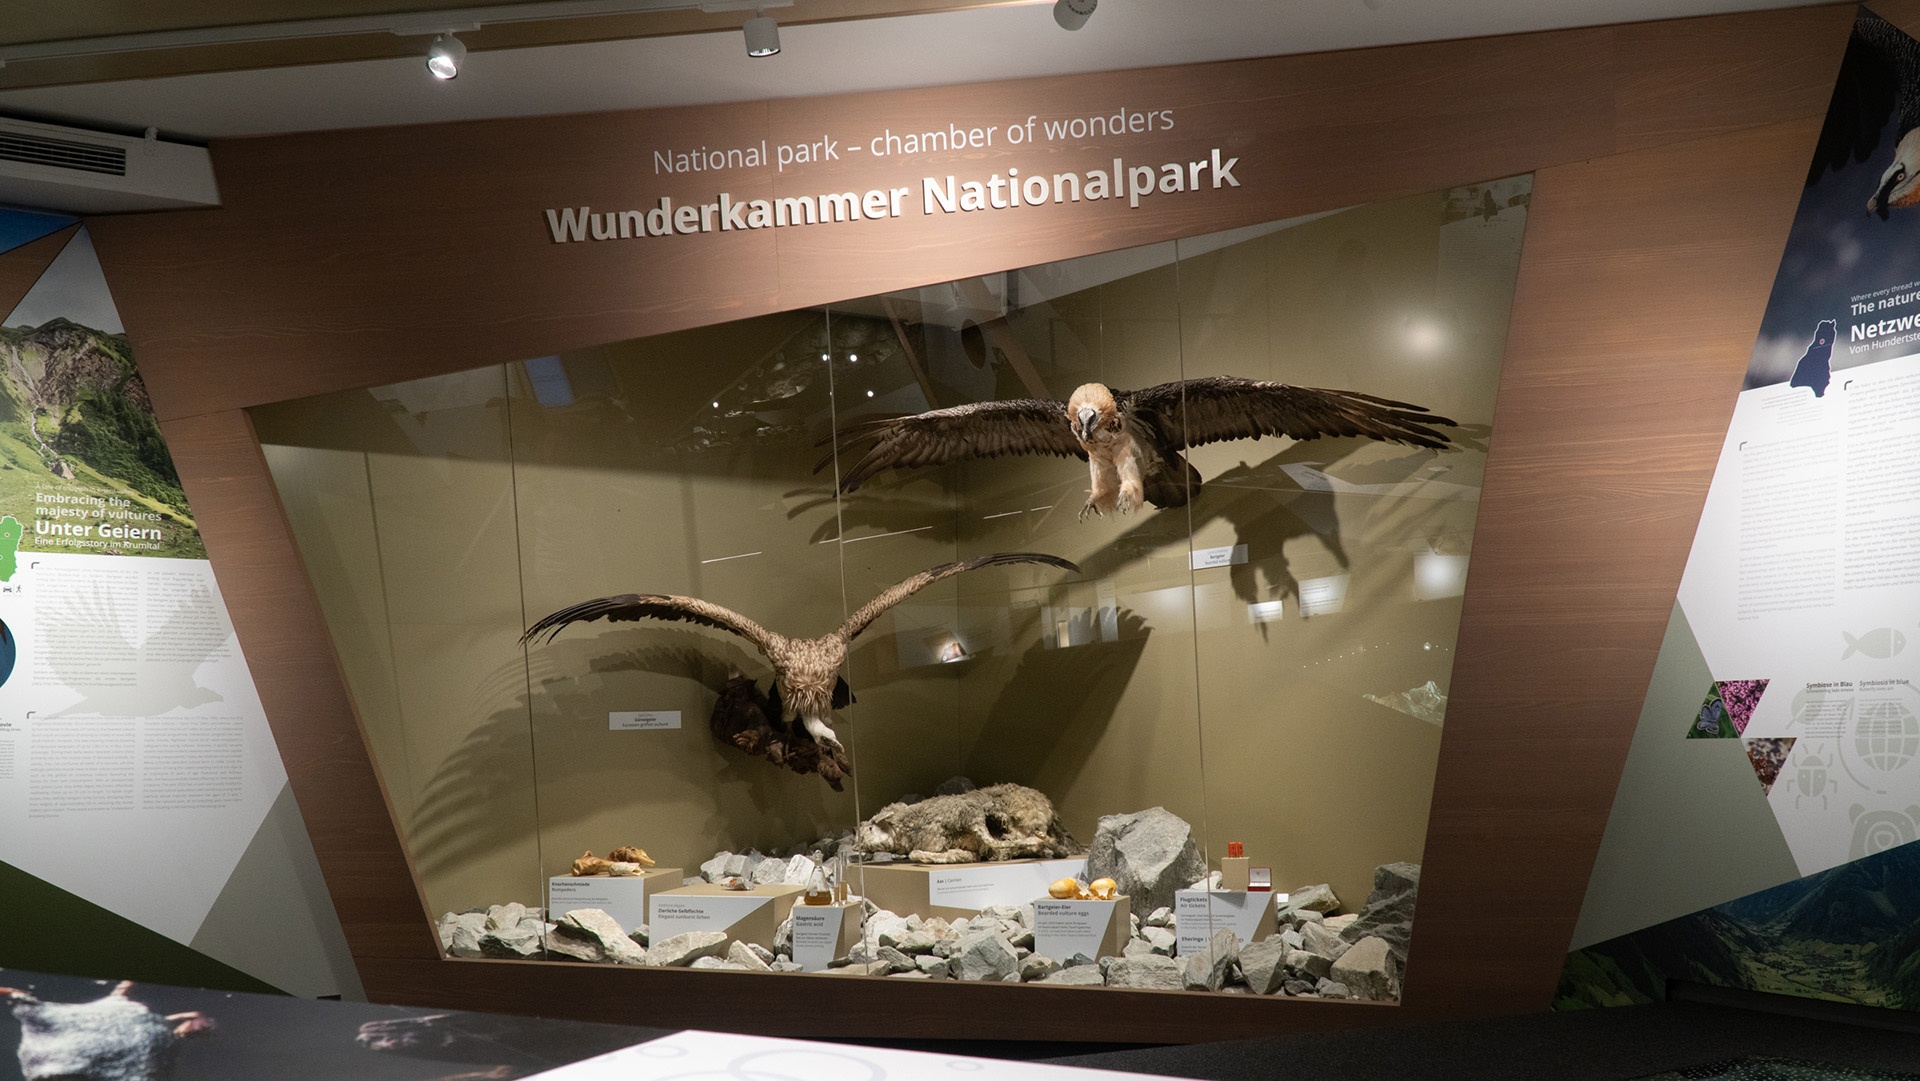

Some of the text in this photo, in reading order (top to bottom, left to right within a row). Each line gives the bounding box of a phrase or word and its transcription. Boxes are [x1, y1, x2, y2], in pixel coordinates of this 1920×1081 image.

[653, 140, 768, 175] National
[777, 135, 839, 171] park
[871, 125, 998, 158] chamber
[1006, 114, 1037, 145] of
[1043, 106, 1175, 140] wonders
[546, 148, 1240, 245] Wunderkammer Nationalpark
[1851, 293, 1872, 302] Where
[1873, 288, 1890, 297] every
[1891, 281, 1913, 292] thread
[1851, 302, 1875, 316] The
[1851, 312, 1920, 343] Netzwe
[1849, 332, 1920, 355] Vom Hundertste
[35, 492, 106, 508] Embracing
[109, 496, 131, 508] the
[35, 505, 162, 521] majesty of vultures
[35, 520, 162, 540] Unter Geiern
[34, 536, 160, 551] Eine Erfolgsstory im Krumltal
[1806, 682, 1833, 690] Symbiose
[1860, 680, 1888, 688] Symbiosis
